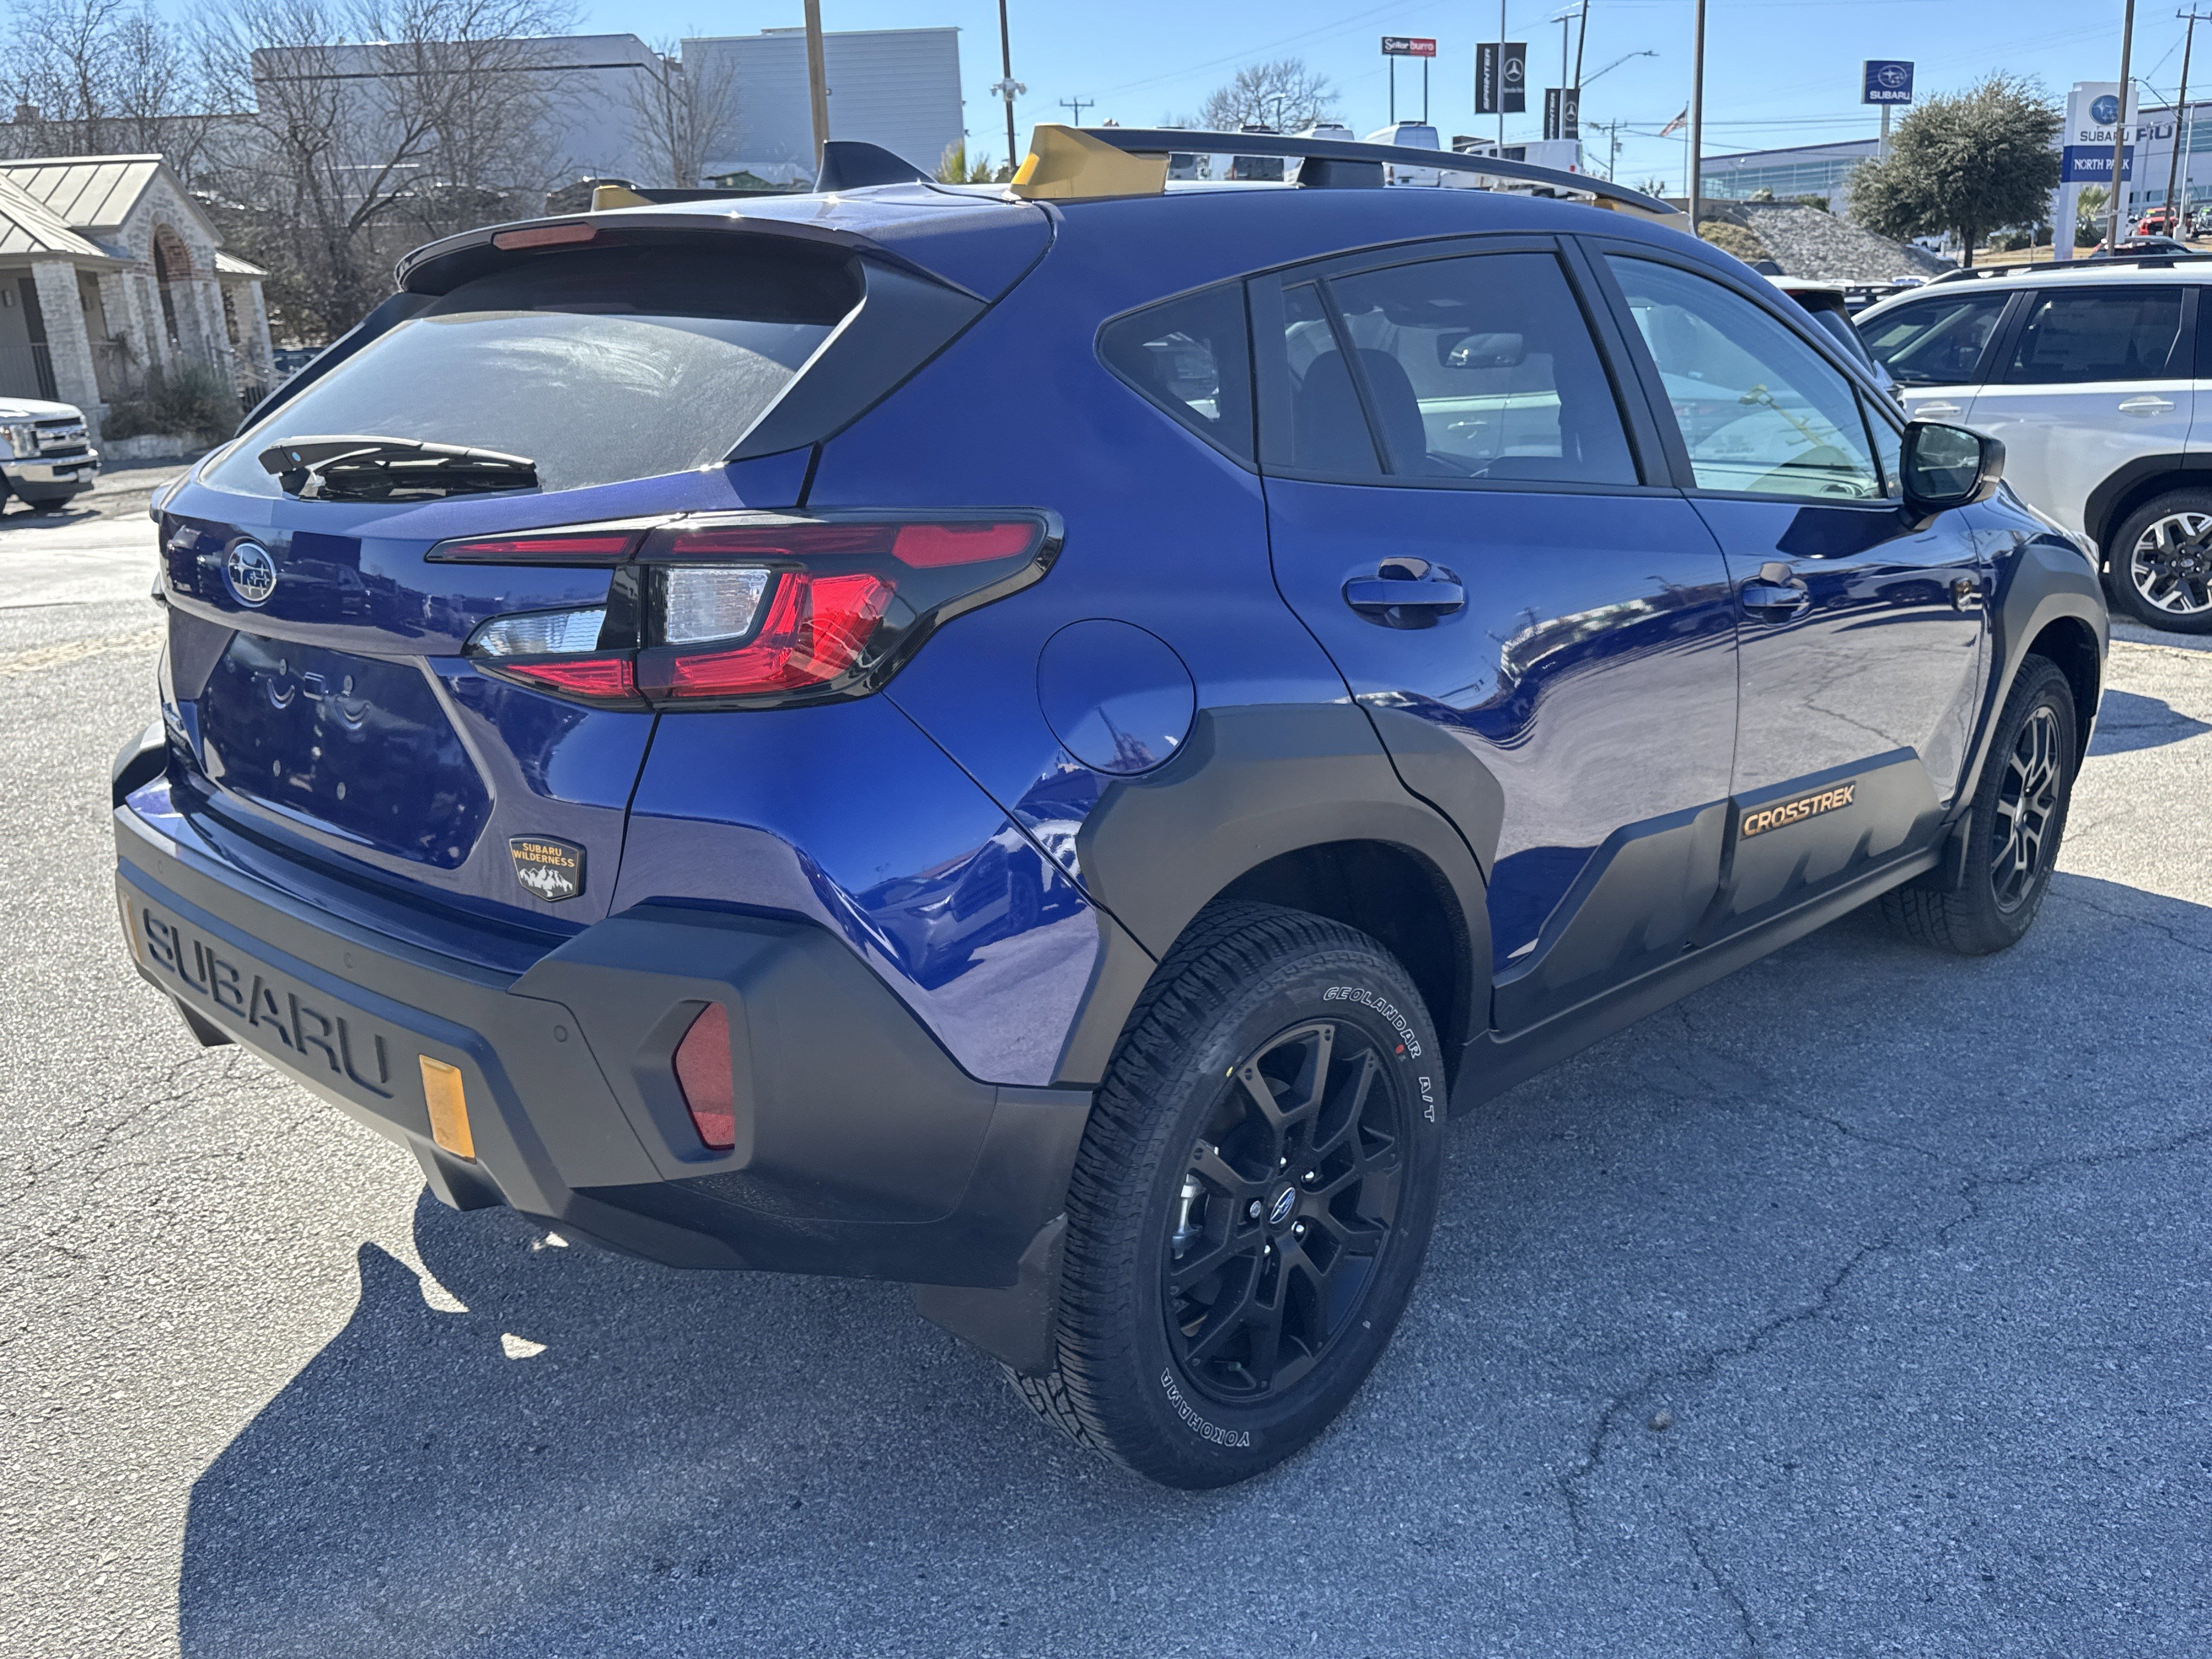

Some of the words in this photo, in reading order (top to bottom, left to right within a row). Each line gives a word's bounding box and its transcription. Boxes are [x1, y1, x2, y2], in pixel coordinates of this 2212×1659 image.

[1870, 90, 1911, 100] SUBARU
[2074, 159, 2104, 170] NORTH
[2106, 159, 2130, 170] PK
[1743, 785, 1855, 836] CROSSTREK
[513, 849, 575, 867] WILDERNESS
[522, 843, 562, 856] SUBARU
[143, 908, 394, 1099] SUBARU
[1323, 986, 1422, 1059] GEOLANDAR
[1418, 1076, 1435, 1123] A/T
[1160, 1367, 1250, 1447] YOKOHAMA
